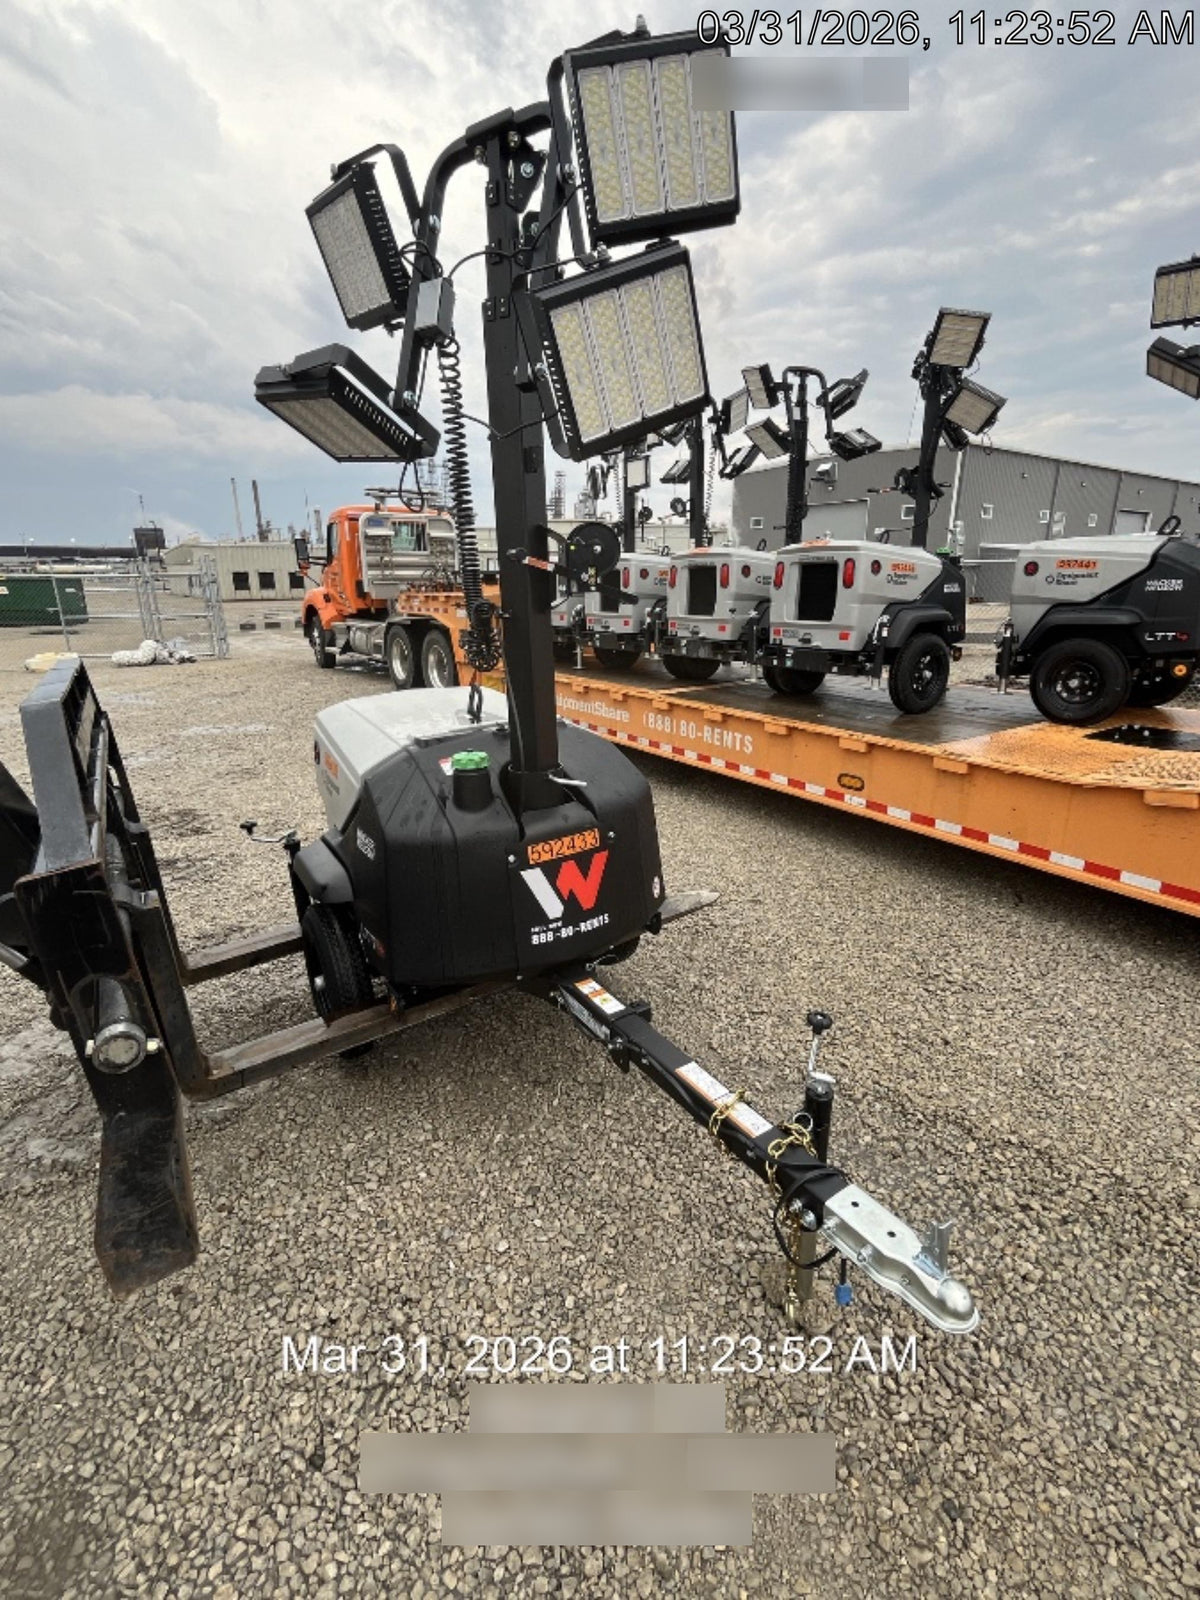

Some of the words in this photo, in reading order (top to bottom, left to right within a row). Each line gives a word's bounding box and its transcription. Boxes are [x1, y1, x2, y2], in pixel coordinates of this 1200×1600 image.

[643, 711, 677, 735] (888)
[680, 720, 753, 754] 80-RENTS
[529, 828, 600, 863] 592433
[531, 913, 609, 945] 888-80-RENTS
